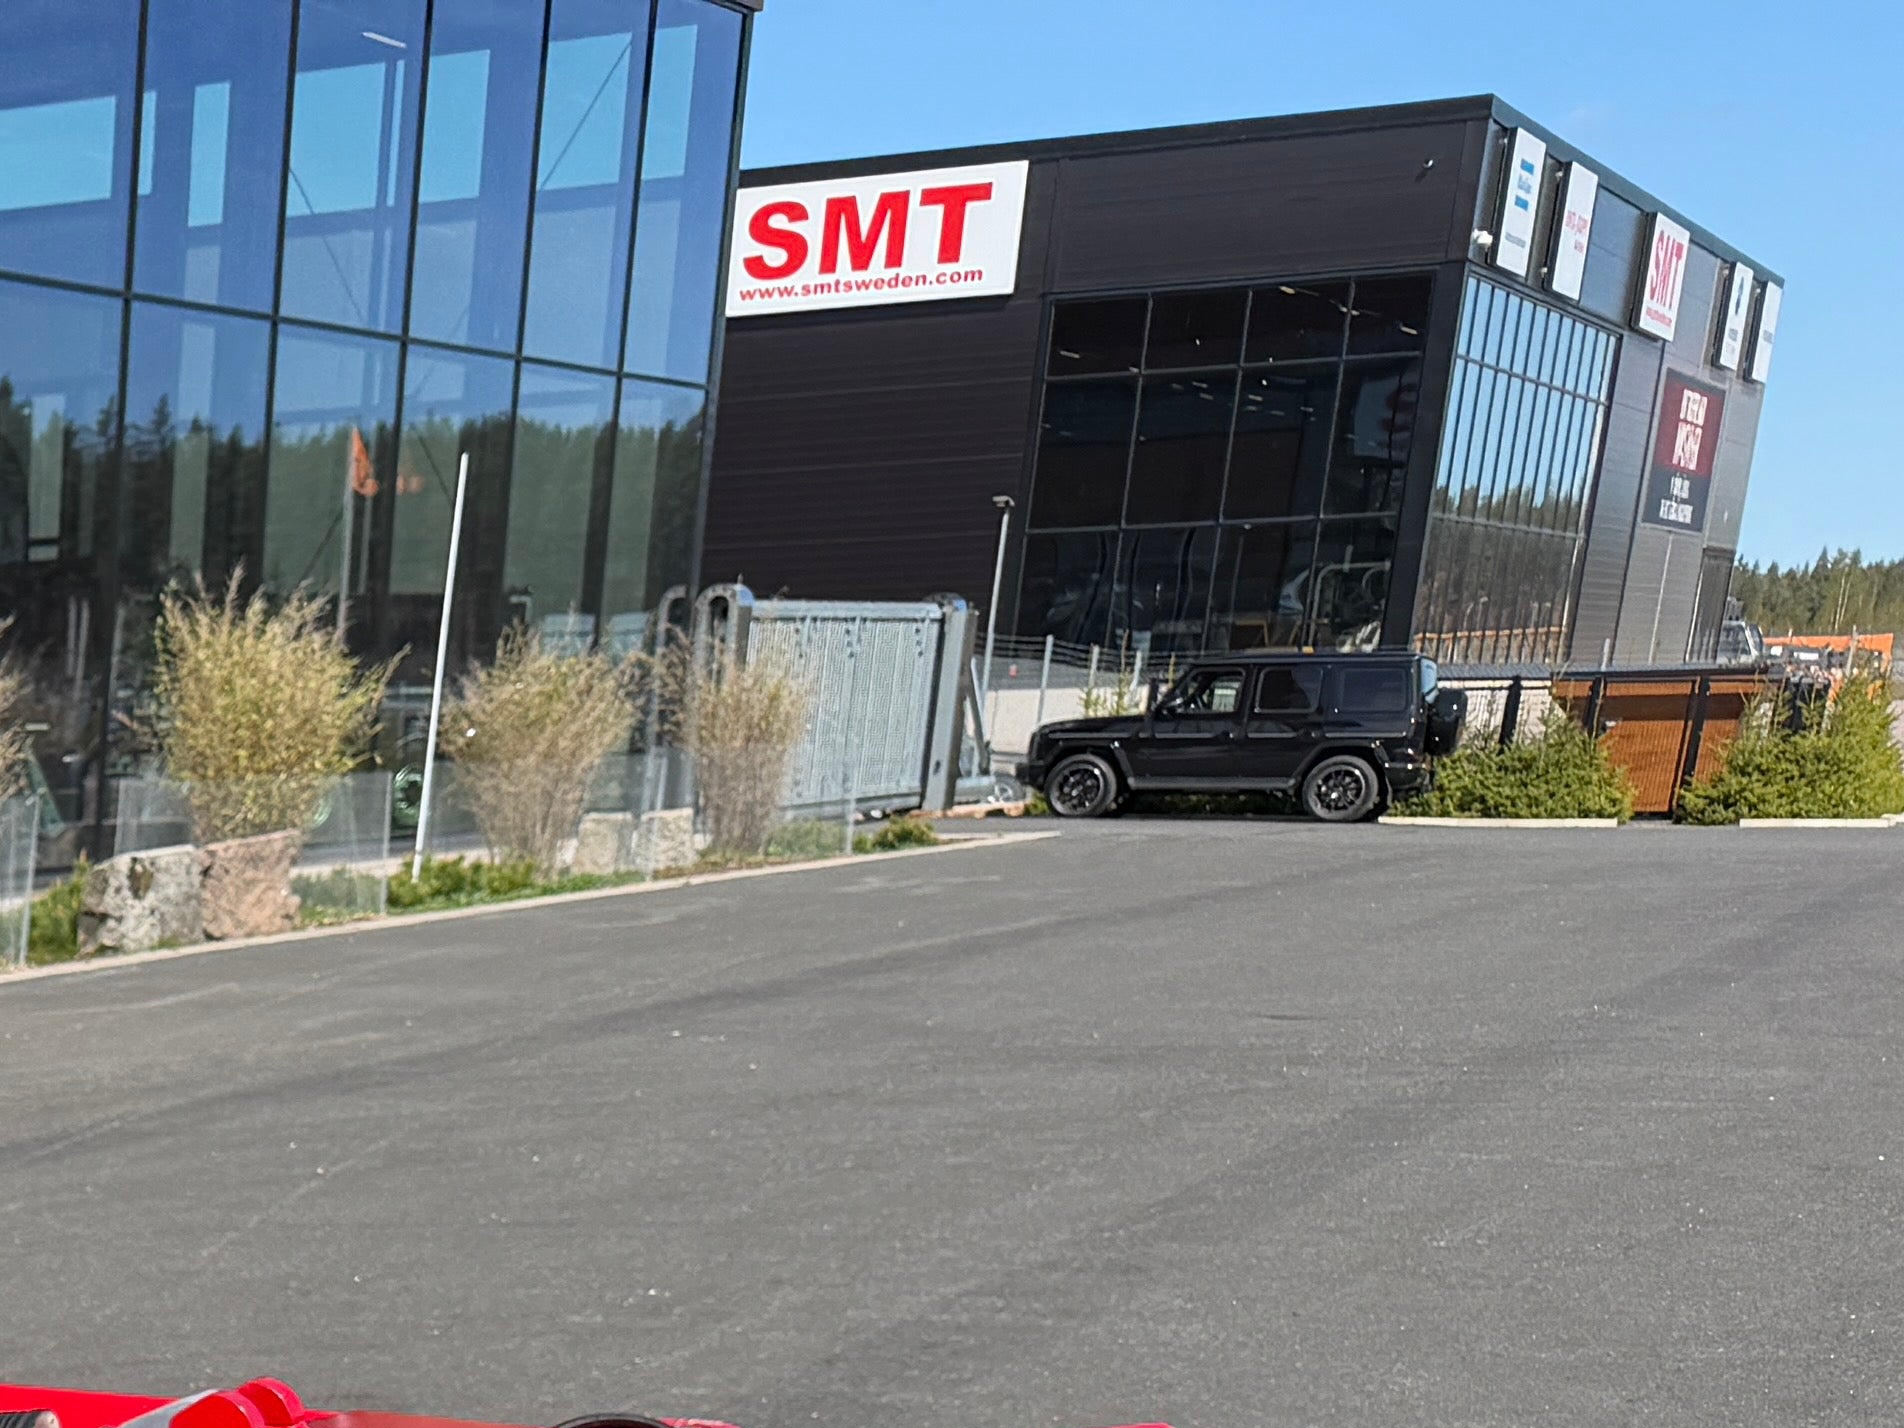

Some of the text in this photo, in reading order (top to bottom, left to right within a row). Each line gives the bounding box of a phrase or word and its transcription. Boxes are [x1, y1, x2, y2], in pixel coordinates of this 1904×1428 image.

[743, 181, 993, 280] SMT
[1649, 229, 1685, 310] SMT
[739, 268, 983, 301] www.smtsweden.com
